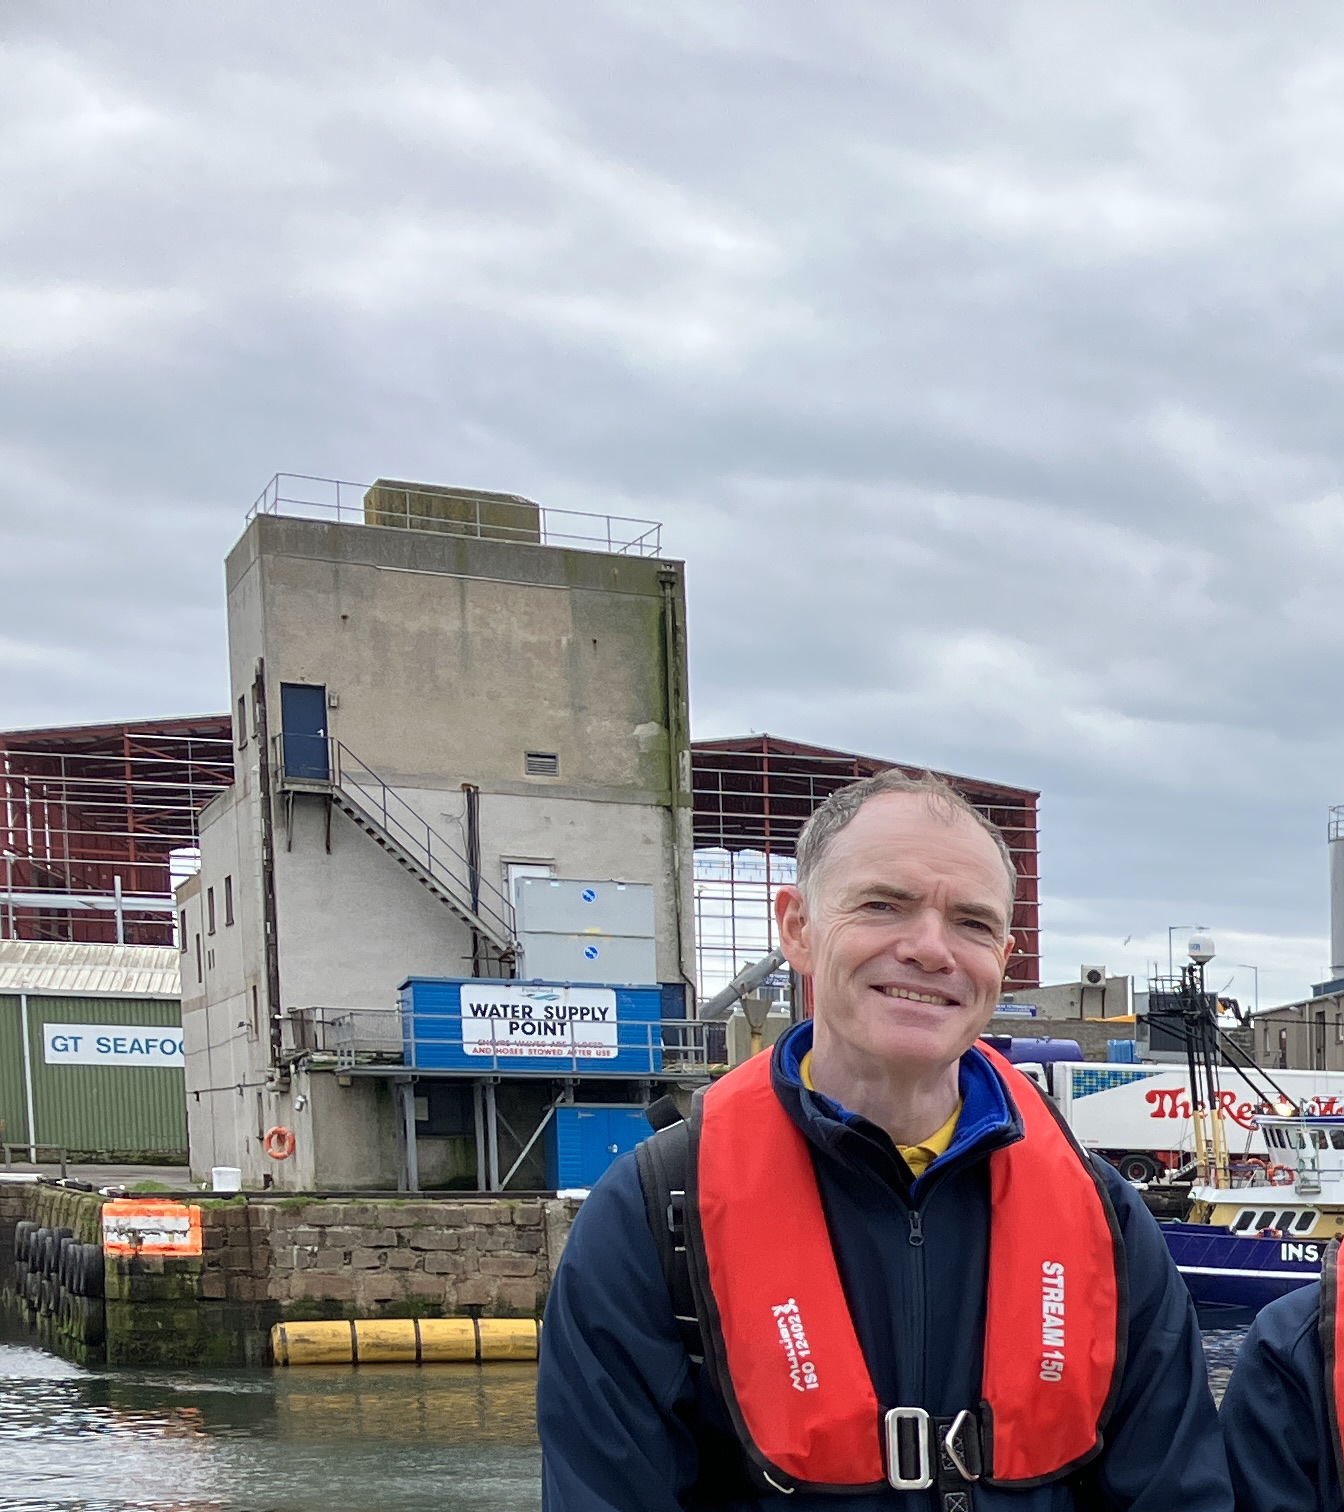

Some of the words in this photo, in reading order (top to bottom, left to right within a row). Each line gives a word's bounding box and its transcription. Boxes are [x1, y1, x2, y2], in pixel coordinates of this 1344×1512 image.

[469, 1003, 533, 1019] WATER
[544, 1005, 609, 1021] SUPPLY
[509, 1021, 567, 1036] POINT
[51, 1035, 83, 1053] GT
[496, 1048, 524, 1056] HOSES
[1281, 1243, 1319, 1262] INS
[1042, 1261, 1065, 1347] STREAM
[787, 1314, 811, 1357] 12402
[801, 1361, 819, 1390] ISO
[1040, 1350, 1065, 1382] 150
